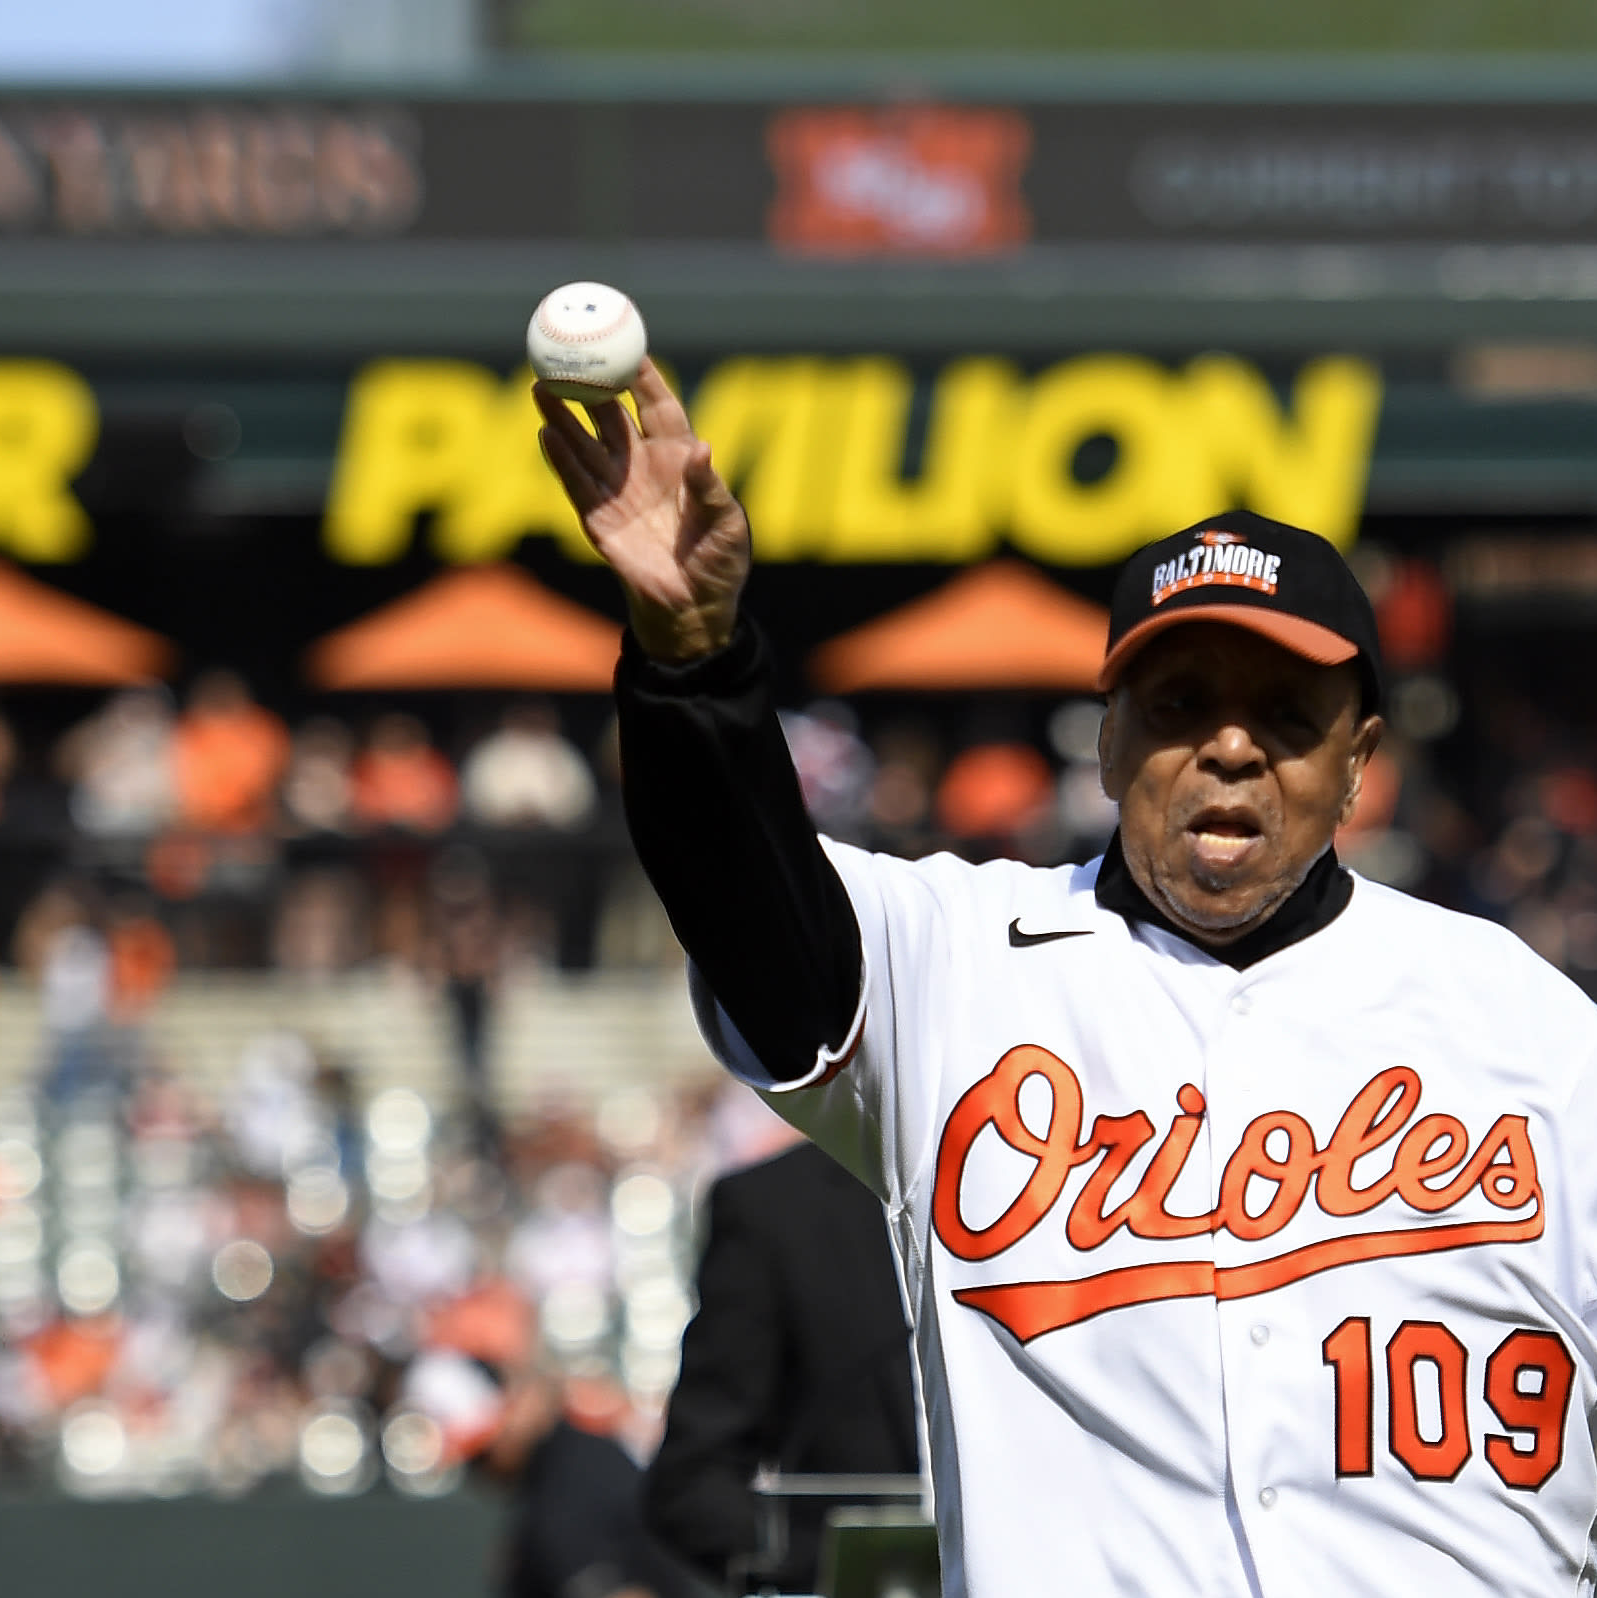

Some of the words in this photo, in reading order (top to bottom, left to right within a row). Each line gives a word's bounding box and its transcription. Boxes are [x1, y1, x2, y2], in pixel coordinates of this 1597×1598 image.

[47, 101, 422, 233] YARDS
[1153, 544, 1281, 597] BALTIMORE
[932, 1043, 1543, 1261] Orioles
[1322, 1316, 1577, 1492] 109
